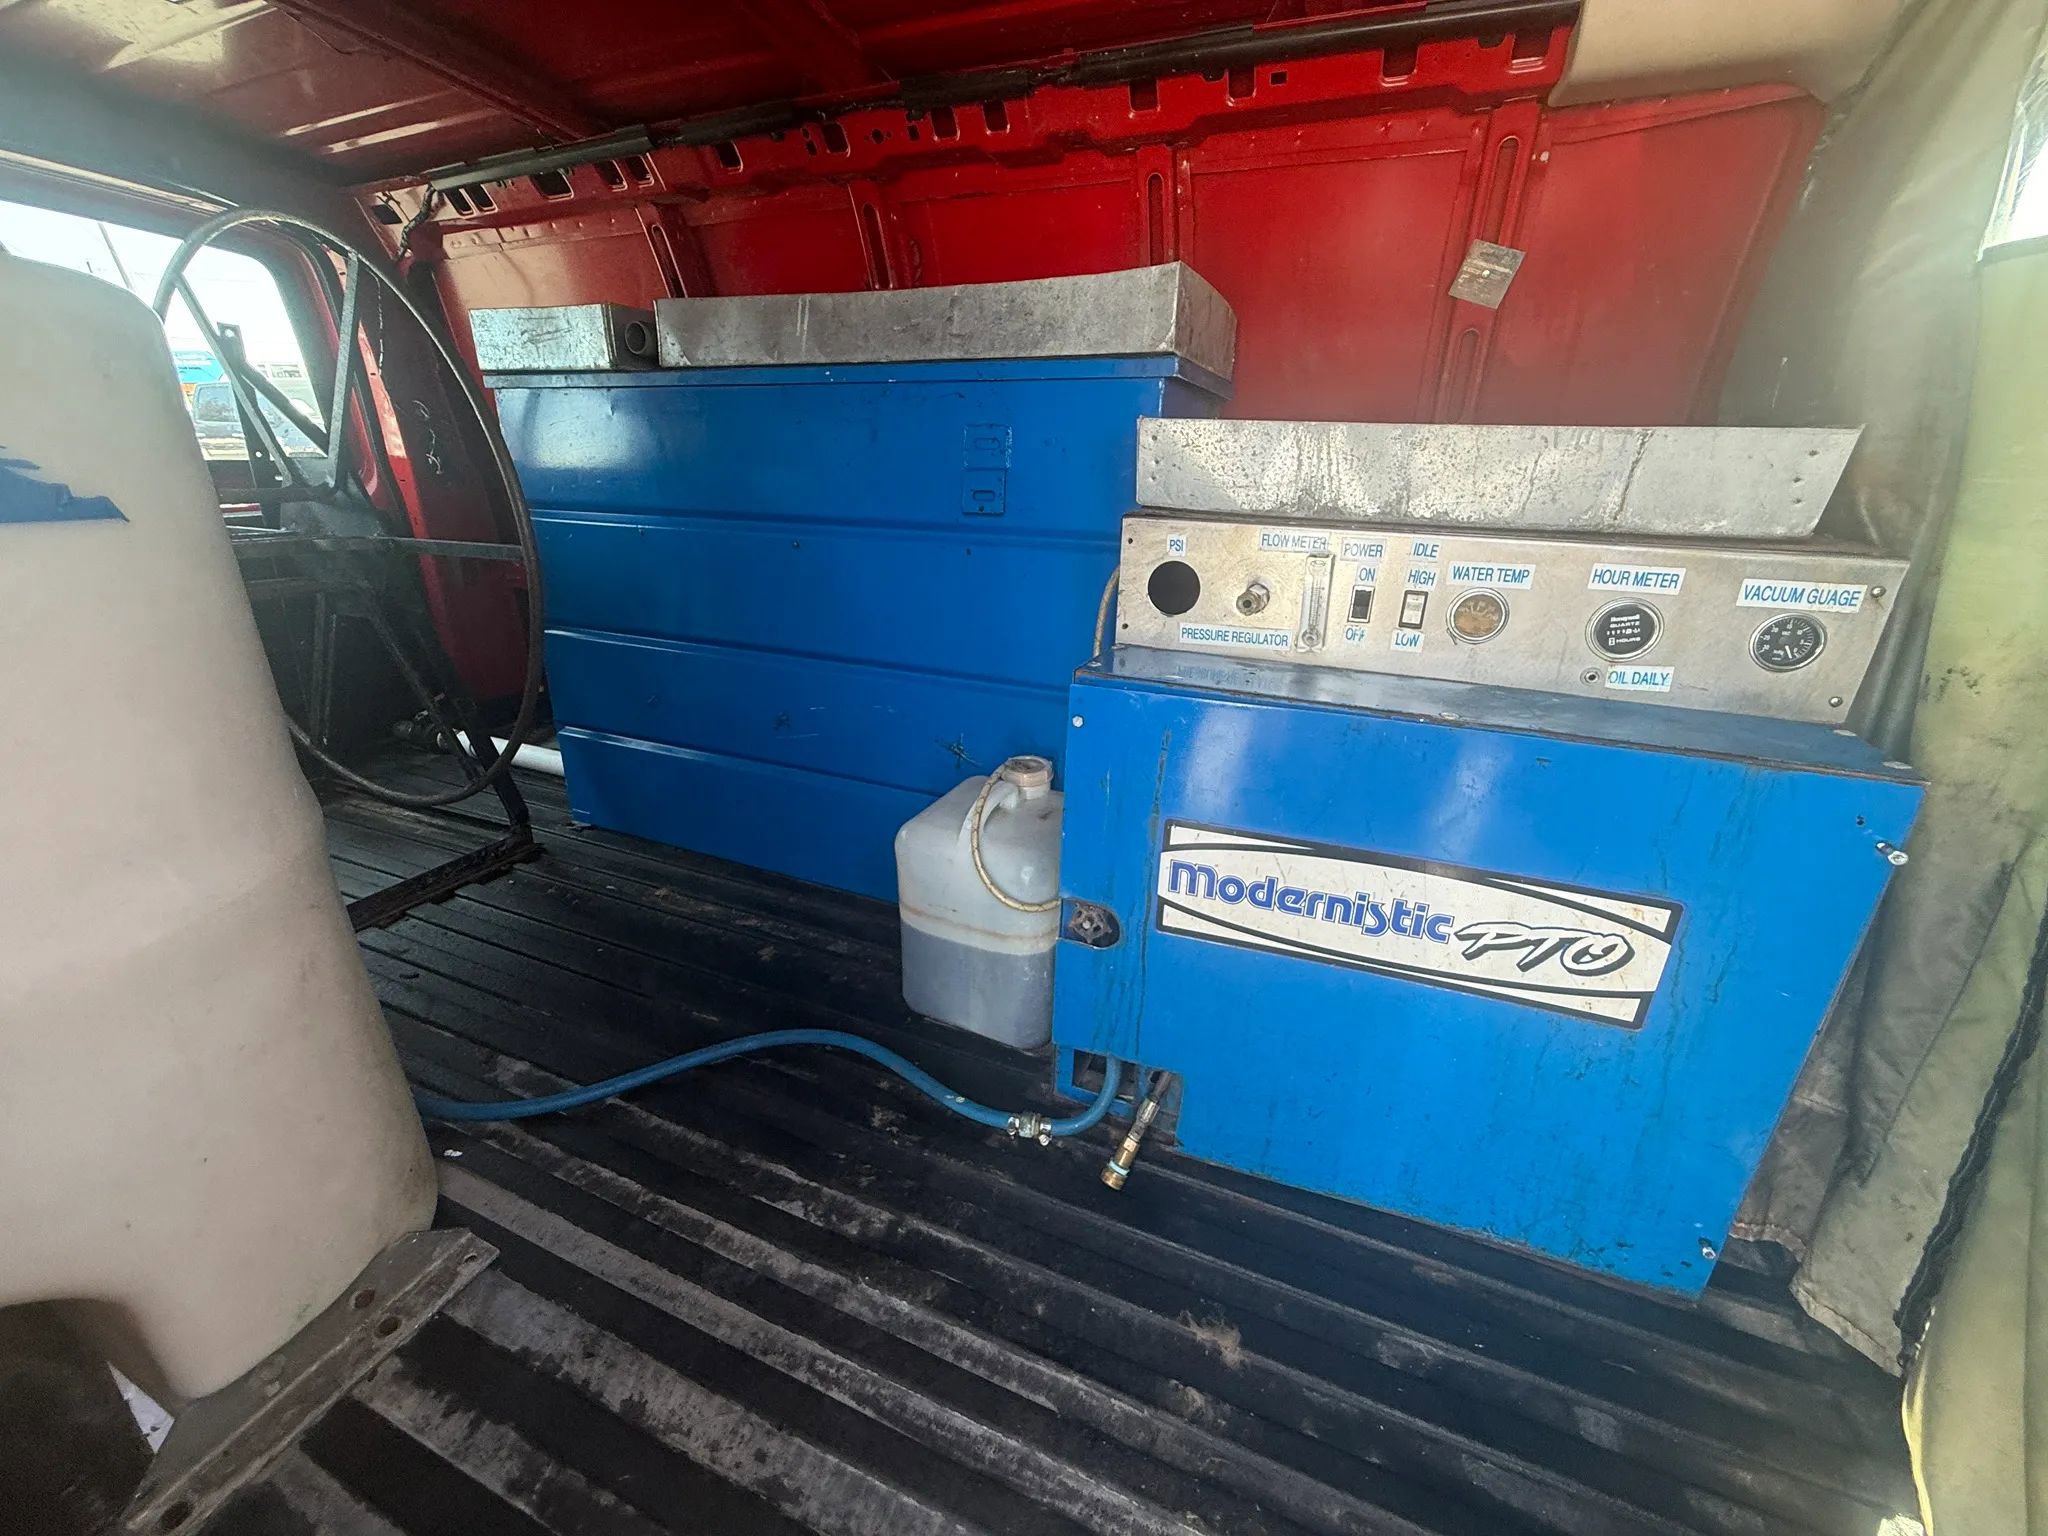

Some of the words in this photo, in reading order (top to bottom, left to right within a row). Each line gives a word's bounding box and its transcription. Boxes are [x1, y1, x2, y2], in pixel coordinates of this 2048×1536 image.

[1169, 537, 1184, 553] PSI
[1261, 534, 1292, 548] FLOW
[1292, 536, 1327, 550] METER
[1343, 543, 1383, 558] POWER
[1413, 543, 1439, 558] IDLE
[1359, 567, 1376, 582] ON
[1408, 569, 1436, 586] HIGH
[1453, 566, 1494, 582] WATER
[1497, 568, 1530, 584] TEMP
[1592, 571, 1629, 586] HOUR
[1633, 574, 1680, 589] METER
[1744, 585, 1805, 603] VACUUM
[1806, 589, 1862, 607] GUAGE
[1181, 628, 1229, 643] PRESSURE
[1232, 631, 1288, 647] REGULATOR
[1396, 633, 1420, 647] LOW
[1608, 671, 1629, 685] OIL
[1632, 671, 1670, 687] DAILY
[1454, 921, 1636, 977] PTO
